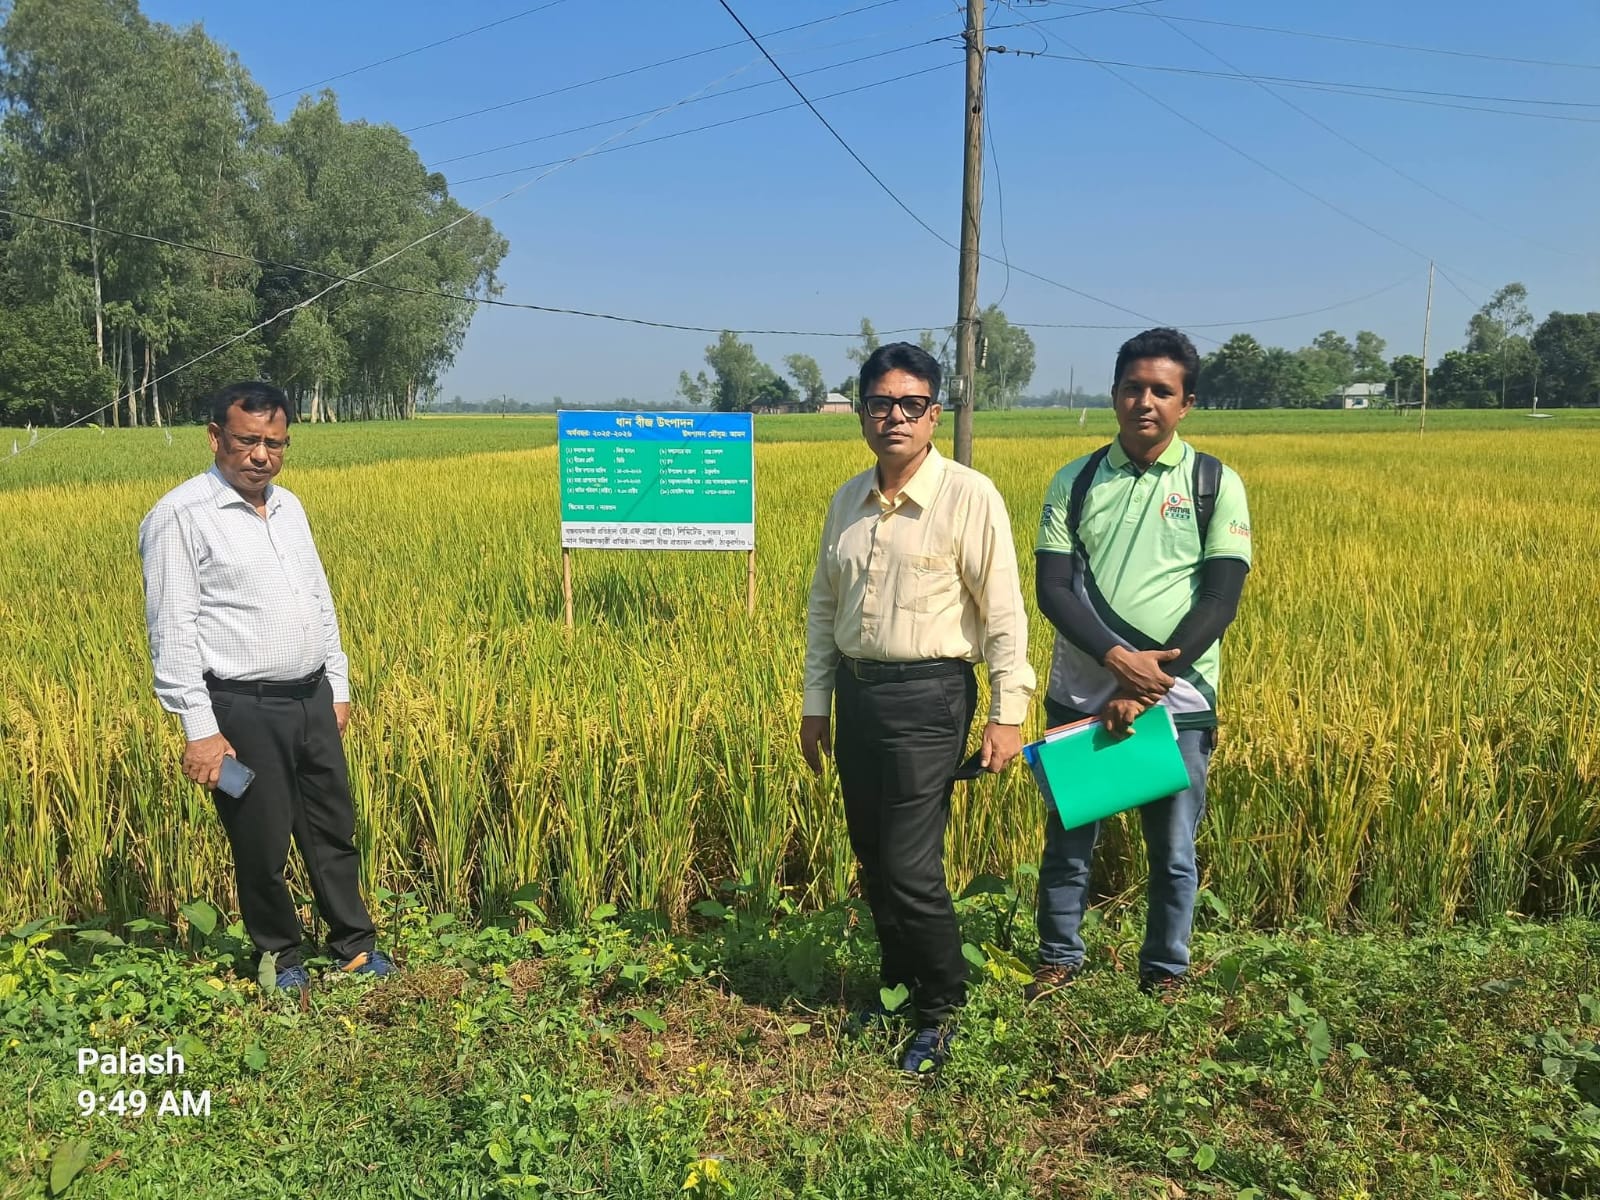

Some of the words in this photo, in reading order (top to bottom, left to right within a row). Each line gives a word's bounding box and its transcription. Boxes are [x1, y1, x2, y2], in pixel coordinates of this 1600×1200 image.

[616, 417, 632, 428] ধান
[635, 415, 653, 428] বীজ
[656, 416, 694, 429] উৎপাদন
